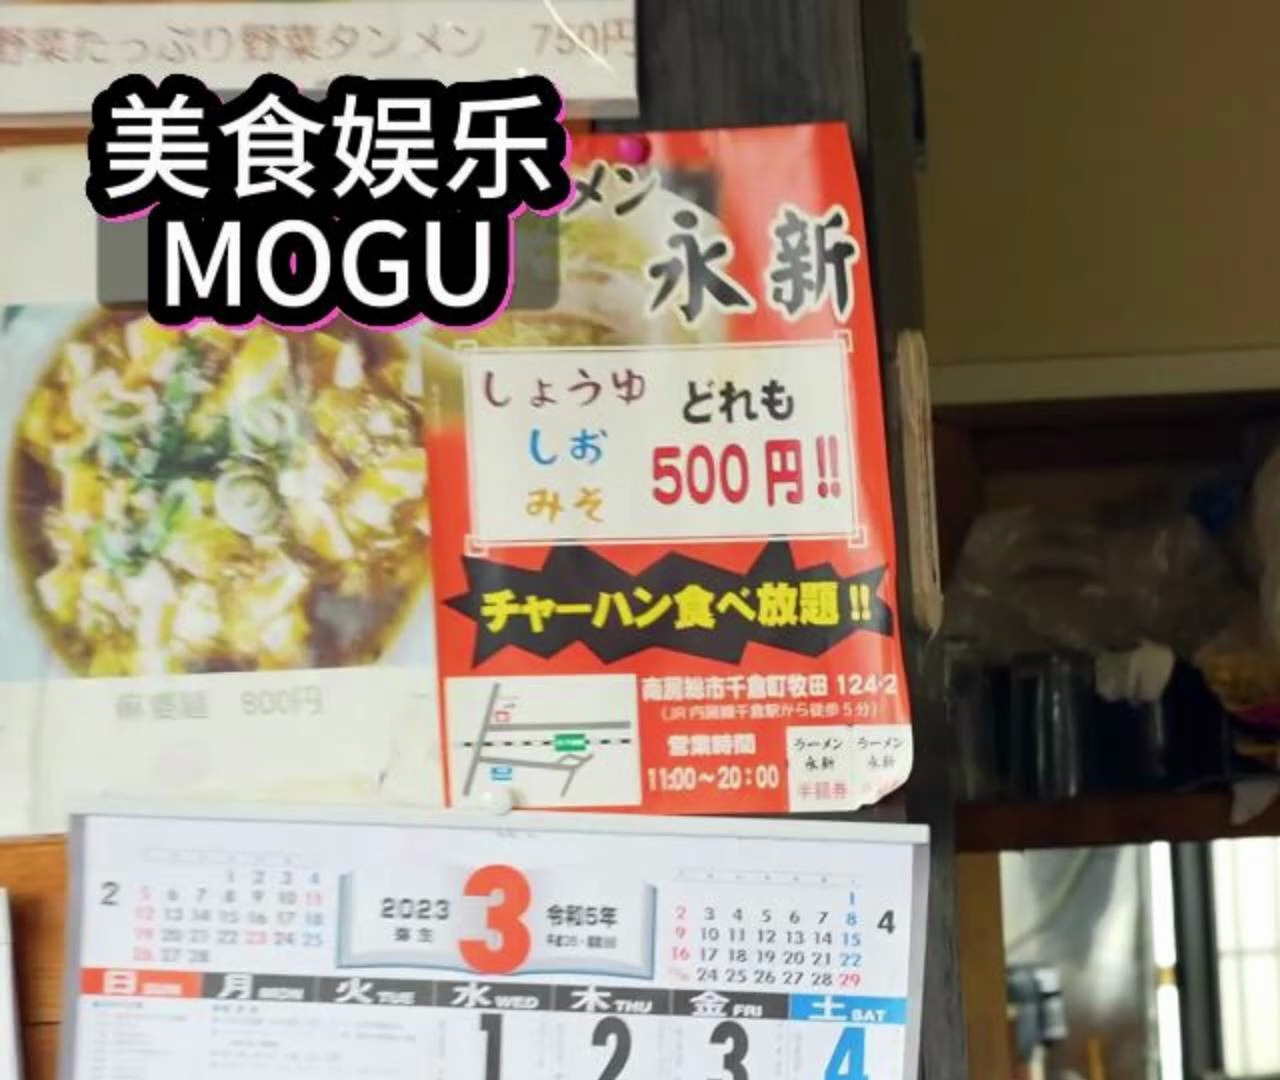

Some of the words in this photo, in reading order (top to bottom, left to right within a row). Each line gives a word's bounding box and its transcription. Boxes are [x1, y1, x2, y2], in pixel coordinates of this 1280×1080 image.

[648, 208, 855, 322] 永新
[484, 369, 646, 408] しょうゆ
[682, 378, 796, 424] どれも
[528, 428, 608, 465] しお
[524, 487, 604, 523] みそ
[667, 732, 757, 757] 営業時間
[100, 881, 121, 906] 2
[849, 892, 856, 905] 1
[379, 897, 451, 921] 2023
[458, 864, 531, 976] 3
[546, 904, 618, 928] 令和5年
[677, 906, 687, 920] 2
[704, 907, 715, 921] 3
[732, 908, 743, 921] 4
[761, 910, 772, 923] 5
[789, 911, 800, 924] 6
[818, 911, 829, 924] 7
[846, 913, 857, 926] 8
[877, 909, 897, 935] 4
[676, 926, 686, 940] 9
[701, 927, 719, 941] 10
[729, 929, 746, 942] 11
[758, 930, 776, 943] 12
[786, 931, 805, 944] 13
[814, 932, 833, 945] 14
[843, 933, 861, 946] 15
[672, 946, 689, 960] 16
[700, 948, 717, 962] 17
[729, 949, 747, 963] 18
[757, 950, 775, 963] 19
[783, 951, 805, 965] 20
[812, 952, 831, 966] 21
[840, 953, 861, 967] 22
[696, 968, 718, 981] 24
[726, 969, 747, 983] 25
[754, 970, 776, 984] 26
[783, 971, 804, 984] 27
[811, 972, 833, 986] 28
[839, 973, 861, 986] 29
[103, 970, 139, 995] 日
[218, 972, 253, 1000] 月
[335, 978, 374, 1004] 火
[451, 982, 492, 1009] 水
[495, 995, 540, 1010] WED
[570, 983, 612, 1013] 木
[615, 999, 653, 1013] THU
[689, 990, 731, 1017] 金
[732, 1004, 764, 1018] FRI
[809, 994, 847, 1021] 土
[851, 1008, 887, 1023] SAT
